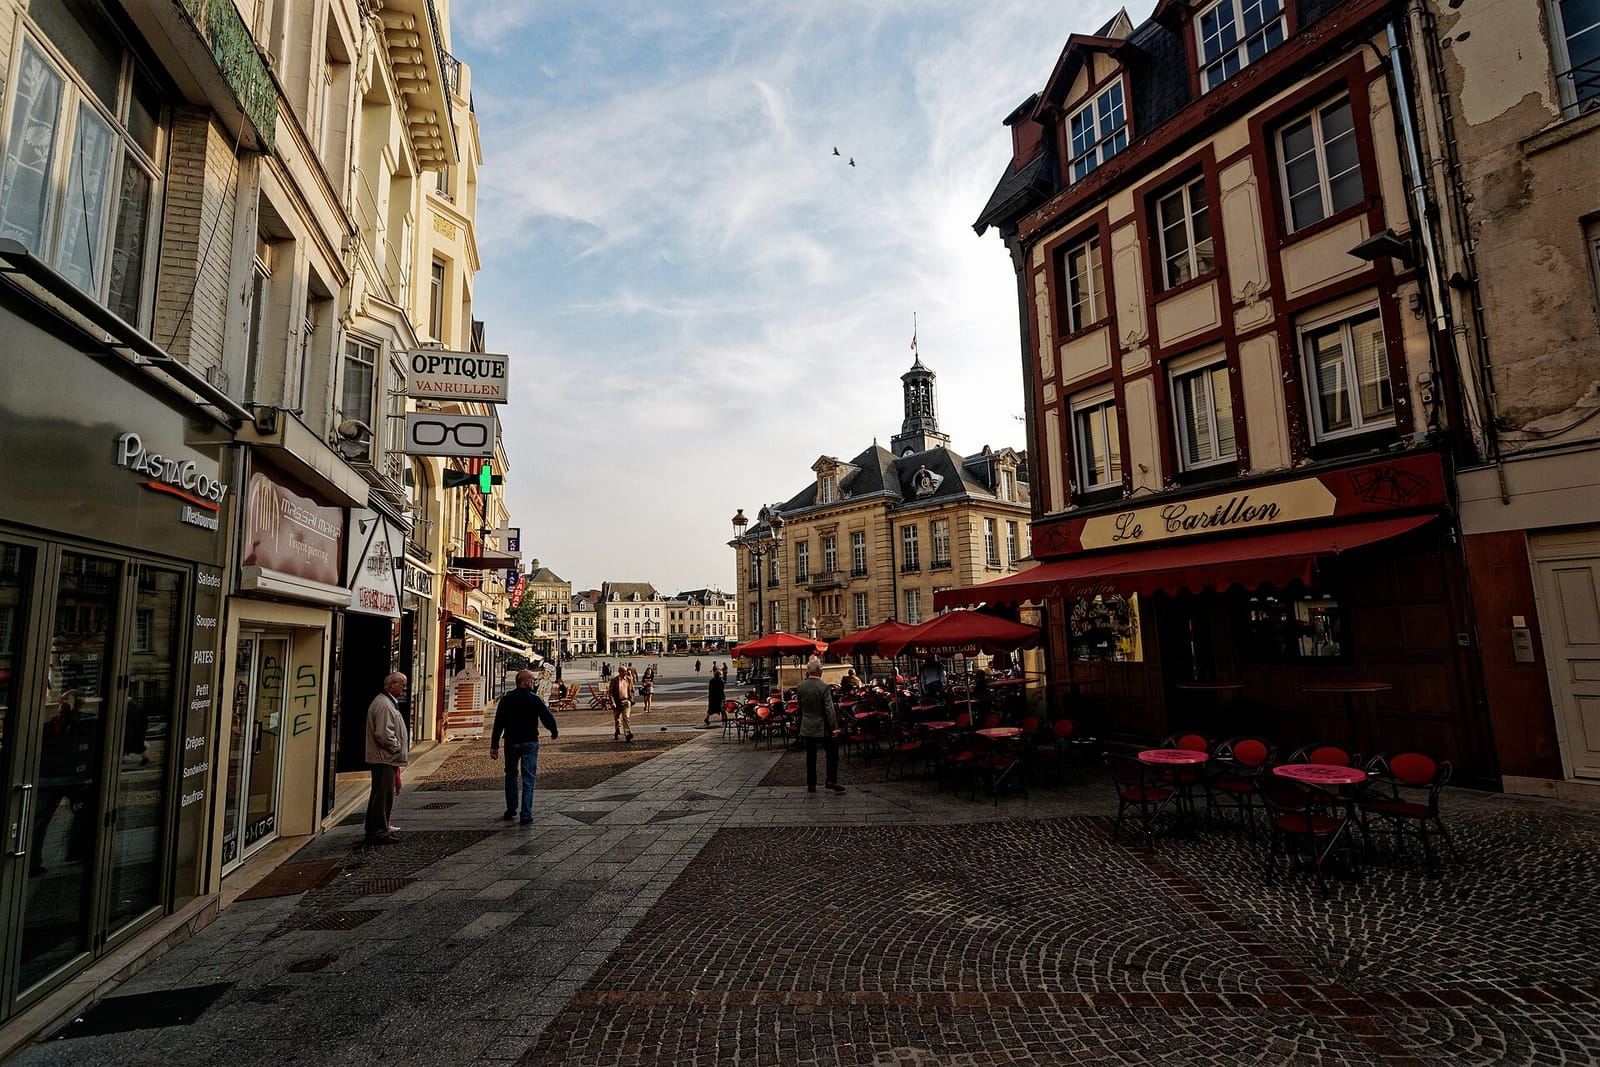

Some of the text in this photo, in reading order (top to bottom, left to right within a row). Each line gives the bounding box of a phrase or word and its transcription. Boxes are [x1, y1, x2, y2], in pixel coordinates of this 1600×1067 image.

[412, 354, 505, 379] OPTIQUE
[415, 380, 500, 396] VANRULLEN
[182, 505, 219, 531] Restaurant
[1112, 494, 1281, 542] Le Carillon
[197, 571, 221, 588] Salades
[512, 576, 525, 608] TABAC
[196, 614, 217, 628] Soupes
[915, 643, 976, 654] LE CARILLON
[193, 650, 214, 665] PATES
[196, 684, 210, 697] Petit
[190, 697, 212, 712] déjeuner
[185, 734, 205, 750] Crêpes
[181, 790, 204, 808] Gaufres
